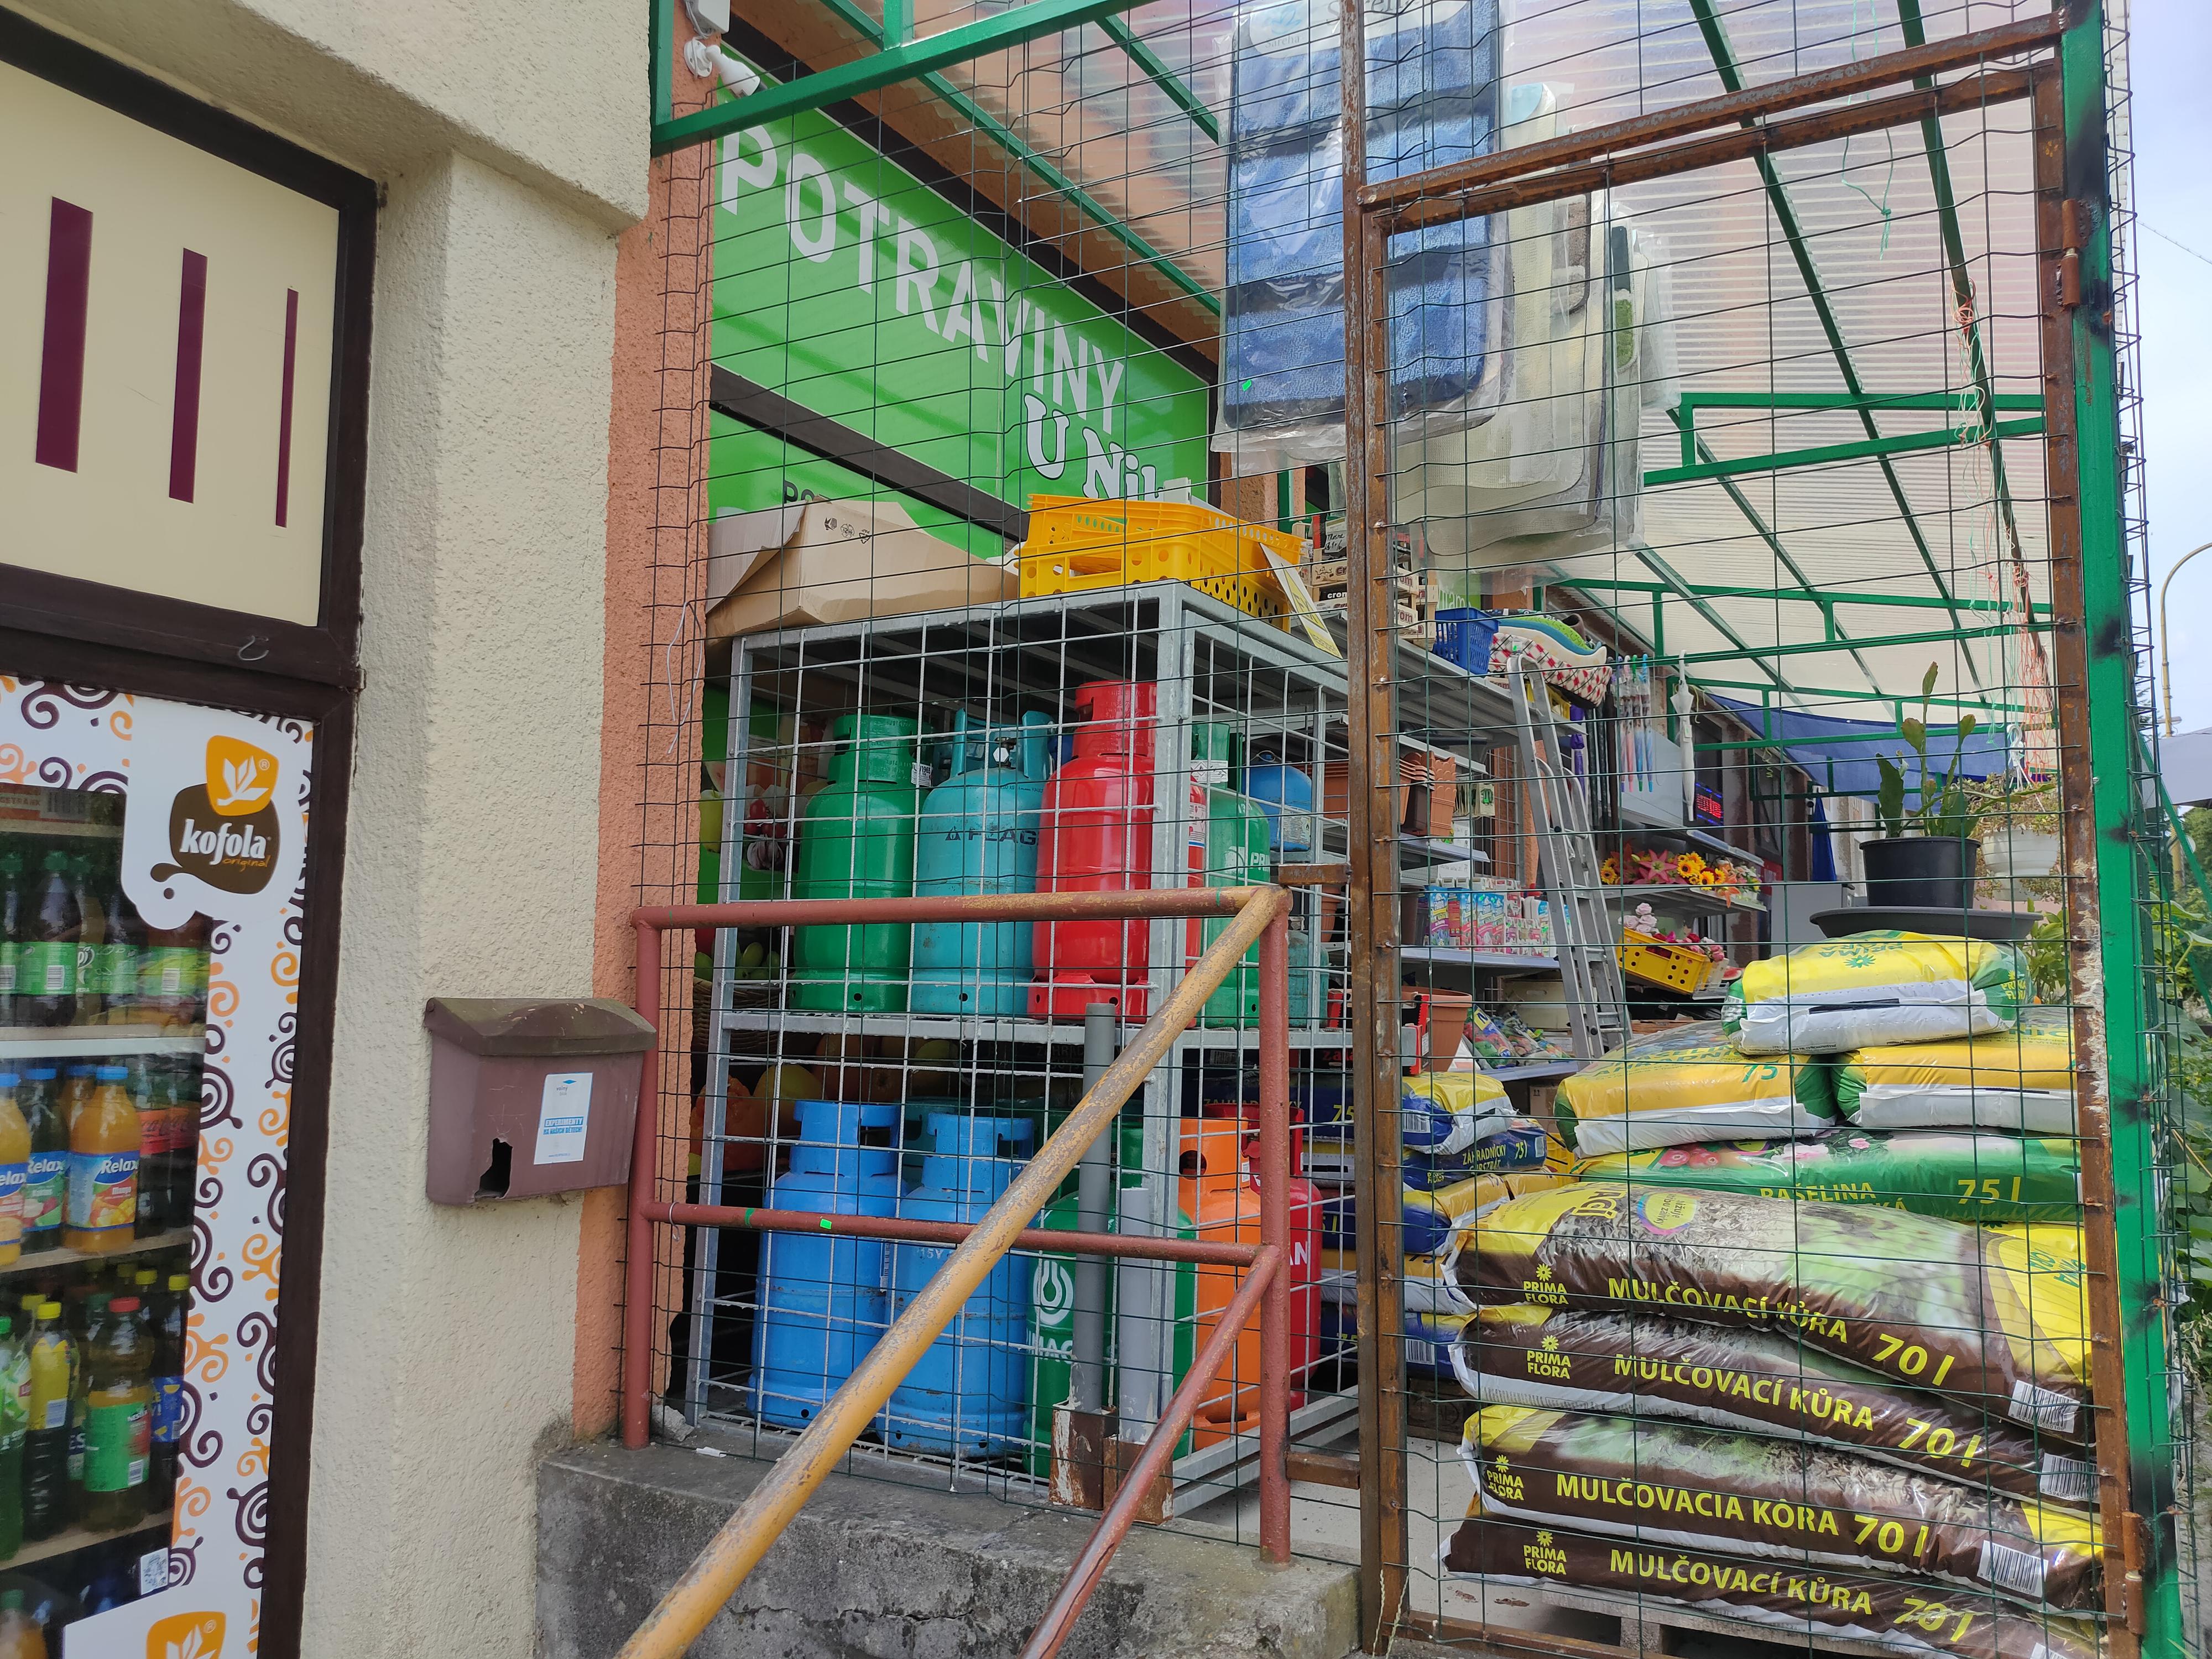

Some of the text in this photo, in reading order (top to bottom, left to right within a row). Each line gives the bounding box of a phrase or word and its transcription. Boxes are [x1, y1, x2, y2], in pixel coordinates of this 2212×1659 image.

[721, 125, 1125, 433] POTRAVINY
[1024, 393, 1070, 480] U
[179, 818, 267, 865] kofola
[968, 826, 1039, 846] FLAG
[222, 855, 271, 872] original
[1742, 1062, 1779, 1083] 75
[545, 1118, 583, 1126] EXPERIMENTY
[100, 1156, 139, 1175] Relax
[0, 1171, 27, 1186] elax
[1958, 1178, 2002, 1205] 75
[1523, 1281, 1568, 1294] PRIMA
[1525, 1293, 1569, 1306] FLORA
[1608, 1278, 1768, 1319] MULČOVACÍ
[1871, 1333, 1928, 1376] 70
[1526, 1350, 1571, 1368] PRIMA
[1527, 1363, 1571, 1380] FLORA
[1614, 1353, 1786, 1406] MULČOVACÍ
[1789, 1388, 1875, 1431] KŮRA
[1897, 1418, 1954, 1460] 70
[1486, 1470, 1525, 1489] PRIMA
[1488, 1483, 1525, 1501] FLORA
[1556, 1474, 1745, 1522] MULČOVACIA
[1753, 1499, 1839, 1536] KÔRA
[1853, 1515, 1905, 1554] 70
[1524, 1545, 1567, 1562] PRIMA
[1525, 1558, 1567, 1575] FLORA
[1610, 1550, 1778, 1594] MULČOVACÍ
[1787, 1575, 1872, 1615] KŮRA
